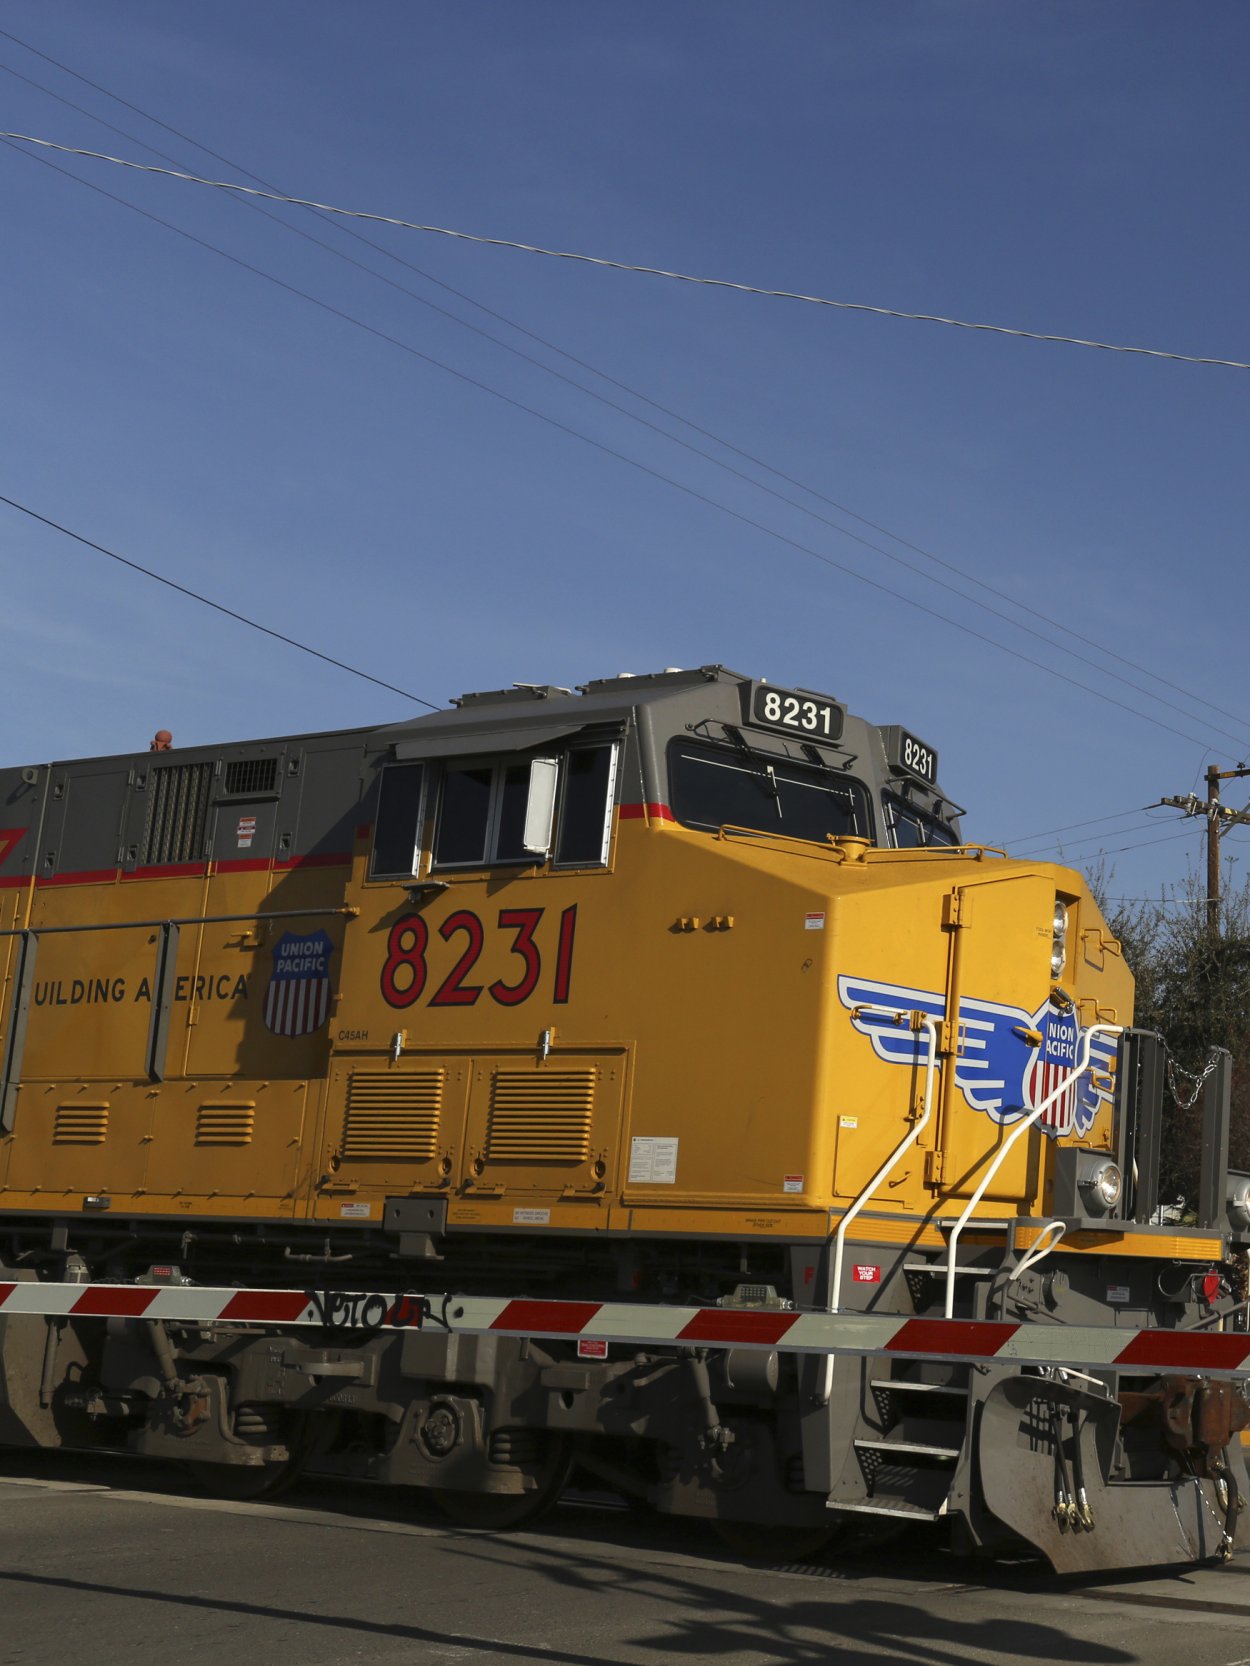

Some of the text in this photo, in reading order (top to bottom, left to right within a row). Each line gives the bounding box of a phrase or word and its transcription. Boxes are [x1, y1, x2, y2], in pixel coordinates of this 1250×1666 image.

[763, 692, 832, 735] 8231
[904, 738, 934, 780] 8231
[280, 941, 324, 957] UNION
[380, 902, 578, 1010] 8231
[276, 956, 326, 973] PACIFIC
[34, 972, 250, 1006] UILDING AERICA
[1049, 1022, 1075, 1043] NION
[1045, 1039, 1075, 1060] ACIFIC
